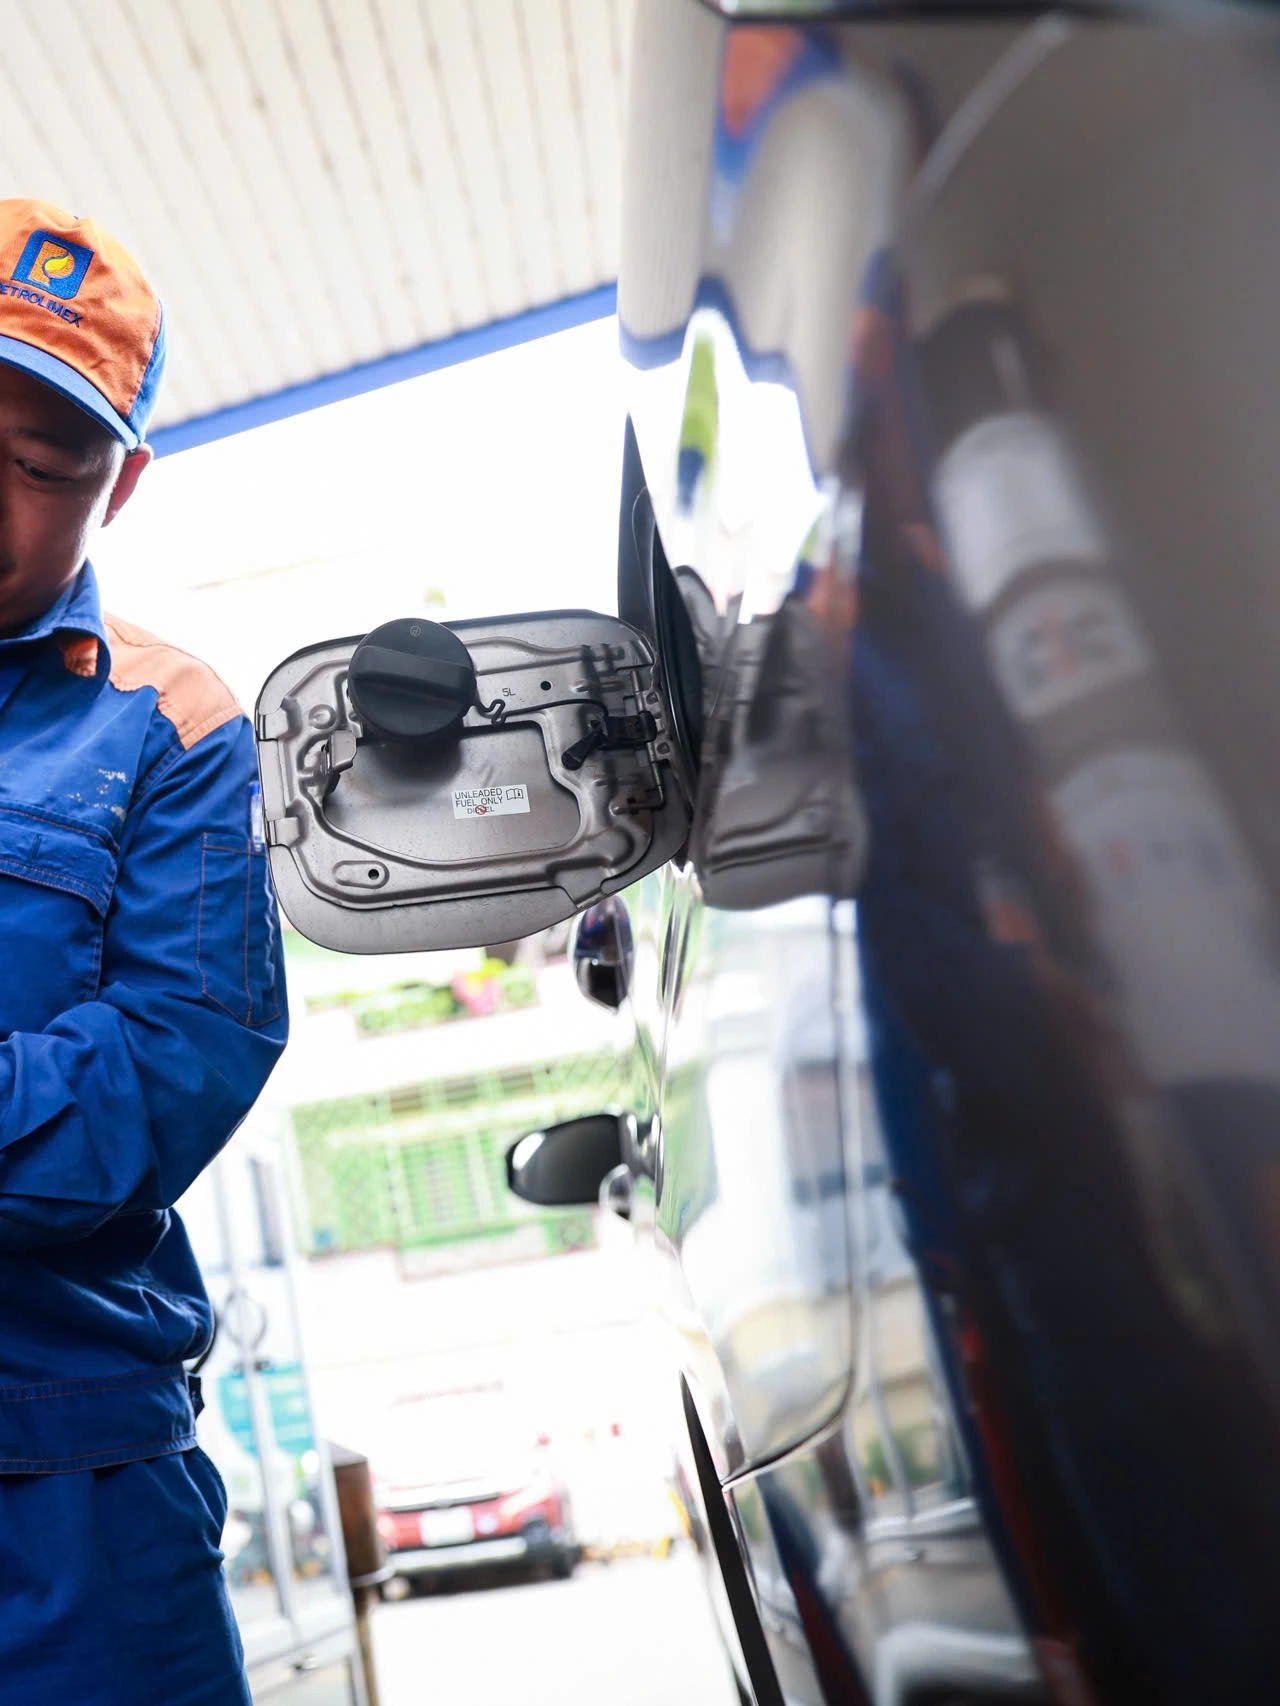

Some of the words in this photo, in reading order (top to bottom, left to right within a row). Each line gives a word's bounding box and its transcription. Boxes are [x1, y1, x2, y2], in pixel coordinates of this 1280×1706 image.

[454, 788, 502, 800] UNLEADED
[455, 800, 477, 808] FUEL
[481, 796, 503, 805] ONLY
